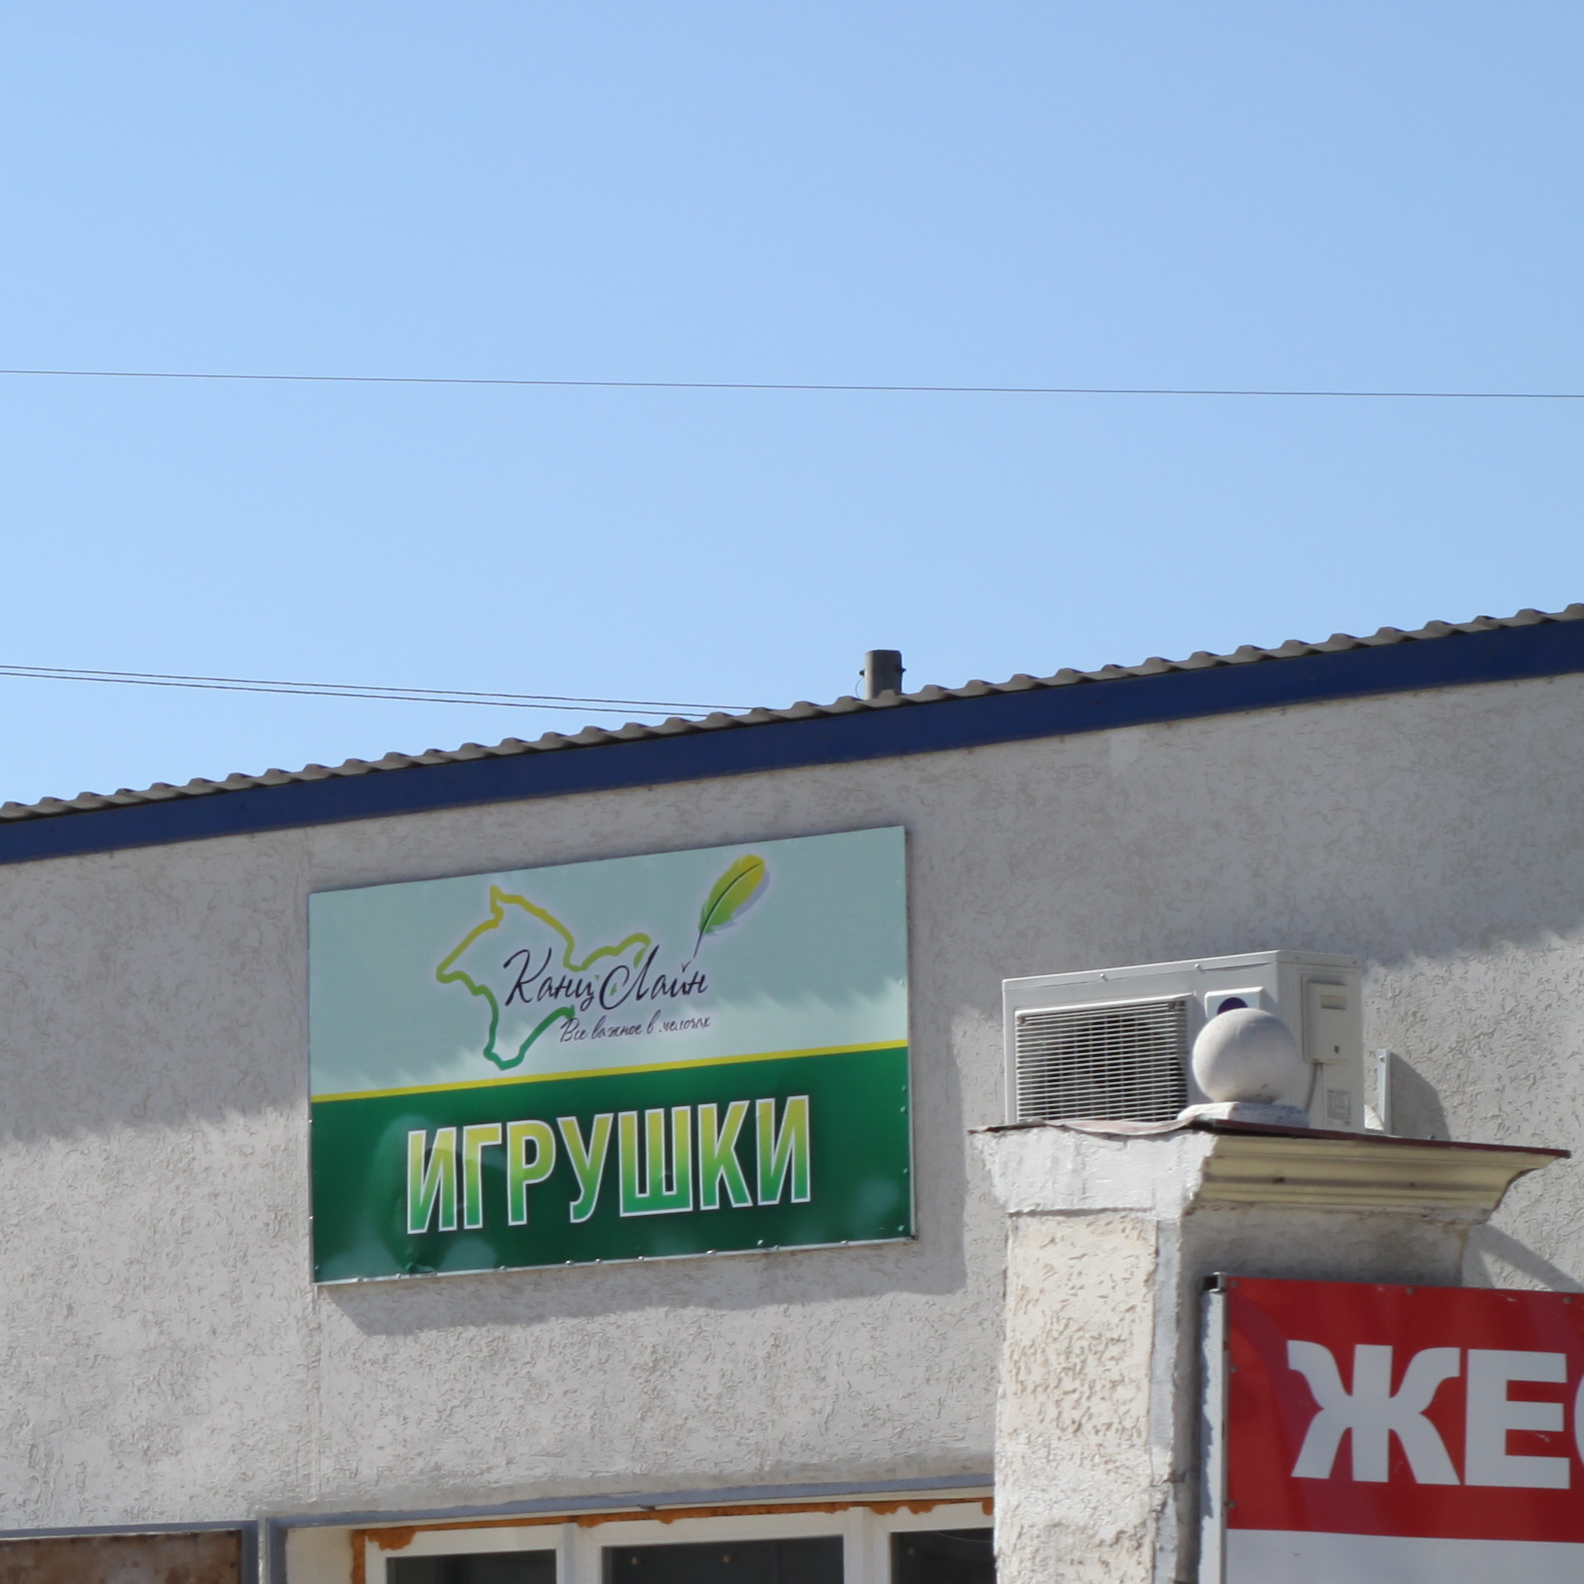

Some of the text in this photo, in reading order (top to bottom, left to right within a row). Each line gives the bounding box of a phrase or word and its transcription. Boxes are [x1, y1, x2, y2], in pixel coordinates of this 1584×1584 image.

[559, 1017, 587, 1043] Все
[591, 1014, 642, 1040] важное
[646, 1009, 662, 1035] в
[407, 1095, 811, 1235] ИГРУШКИ
[1286, 1339, 1584, 1489] ЖЕ
